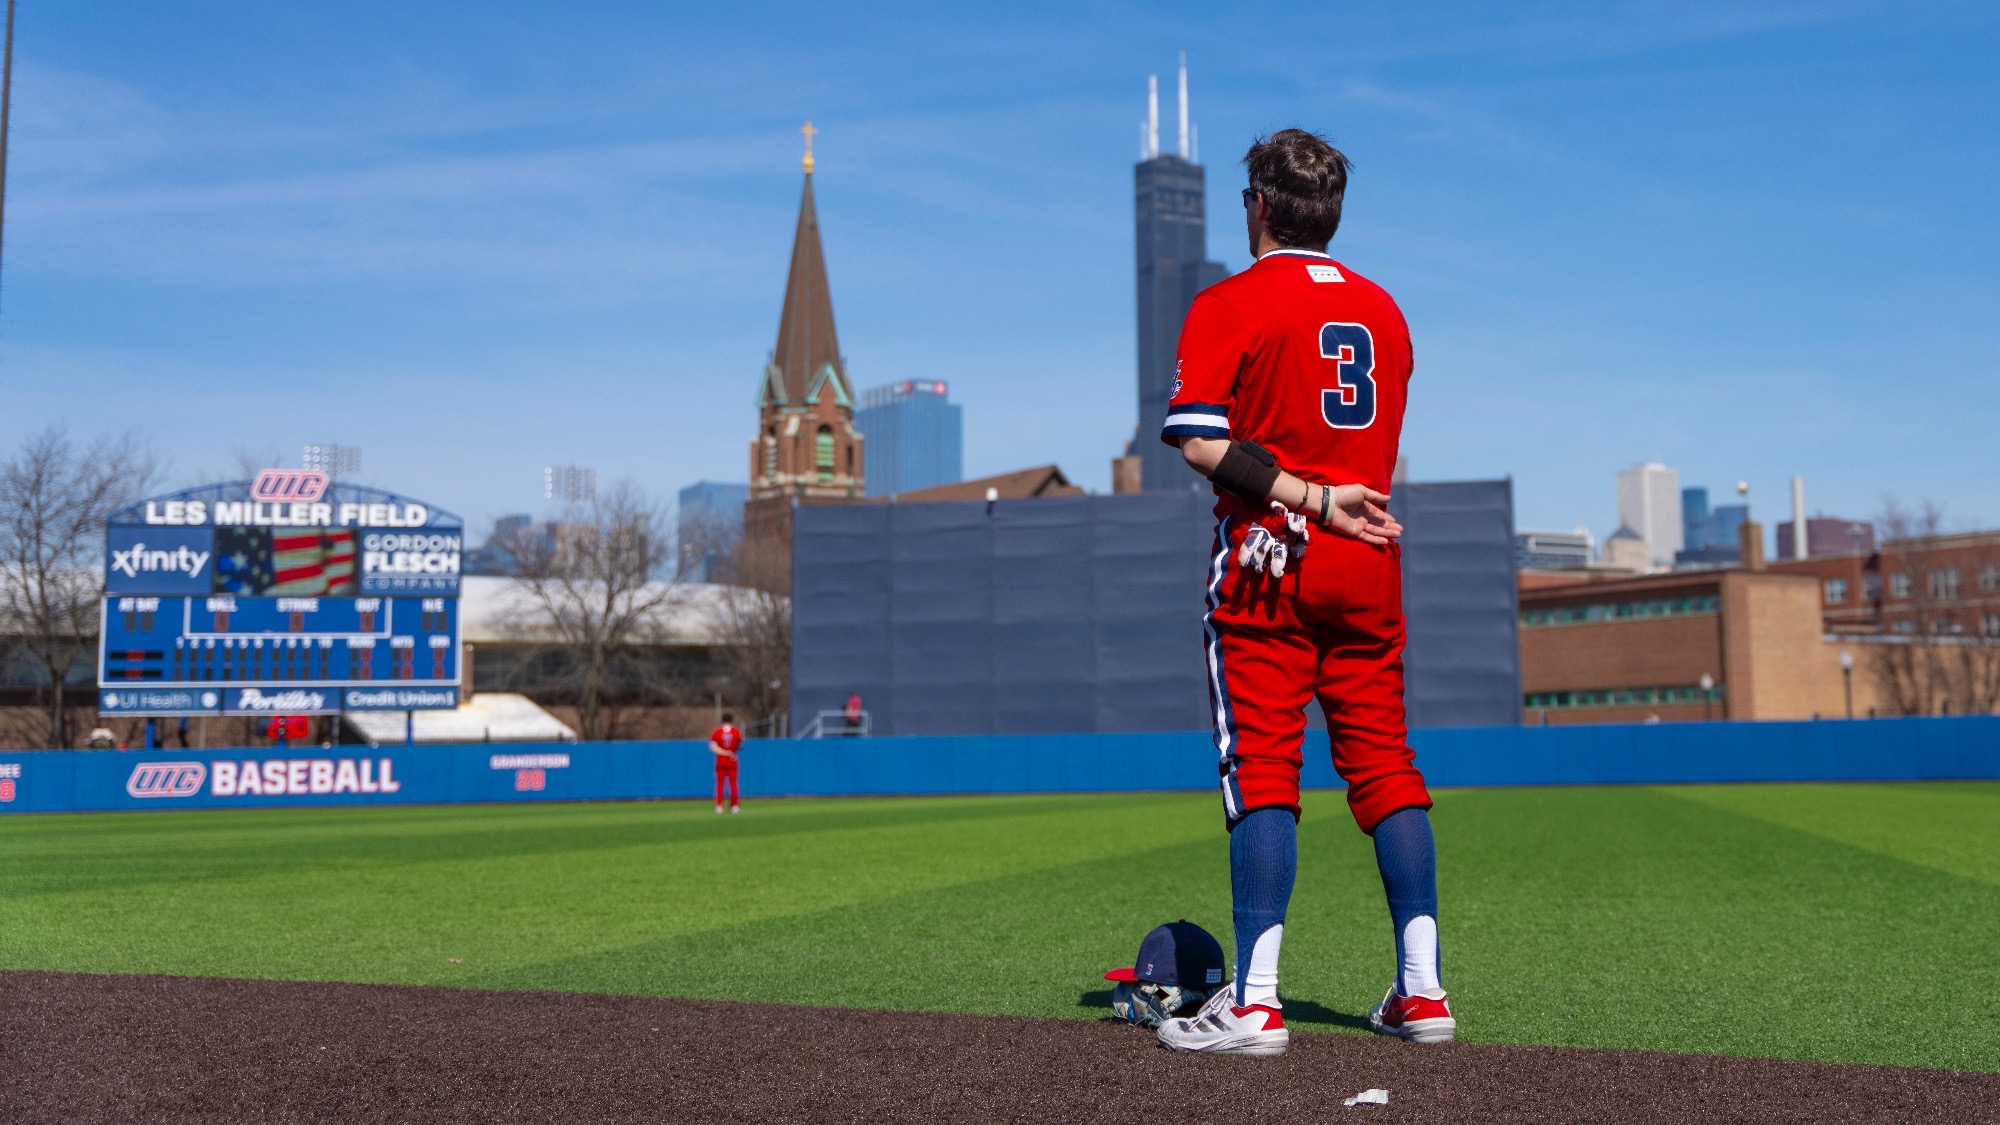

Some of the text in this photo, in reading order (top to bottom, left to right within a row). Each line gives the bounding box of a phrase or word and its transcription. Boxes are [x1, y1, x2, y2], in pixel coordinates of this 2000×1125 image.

[1319, 322, 1376, 429] 3
[254, 472, 325, 499] UIC
[146, 502, 428, 527] LES MILLER FIELD
[363, 534, 460, 552] GORDON
[111, 544, 210, 578] xfinity
[363, 552, 460, 573] FLESCH
[362, 578, 460, 589] COMPANY
[119, 692, 192, 708] UI Health
[346, 690, 397, 706] Credit
[398, 690, 446, 706] Union
[130, 764, 203, 795] UIC
[212, 758, 400, 796] BASEBALL
[515, 769, 546, 791] 28
